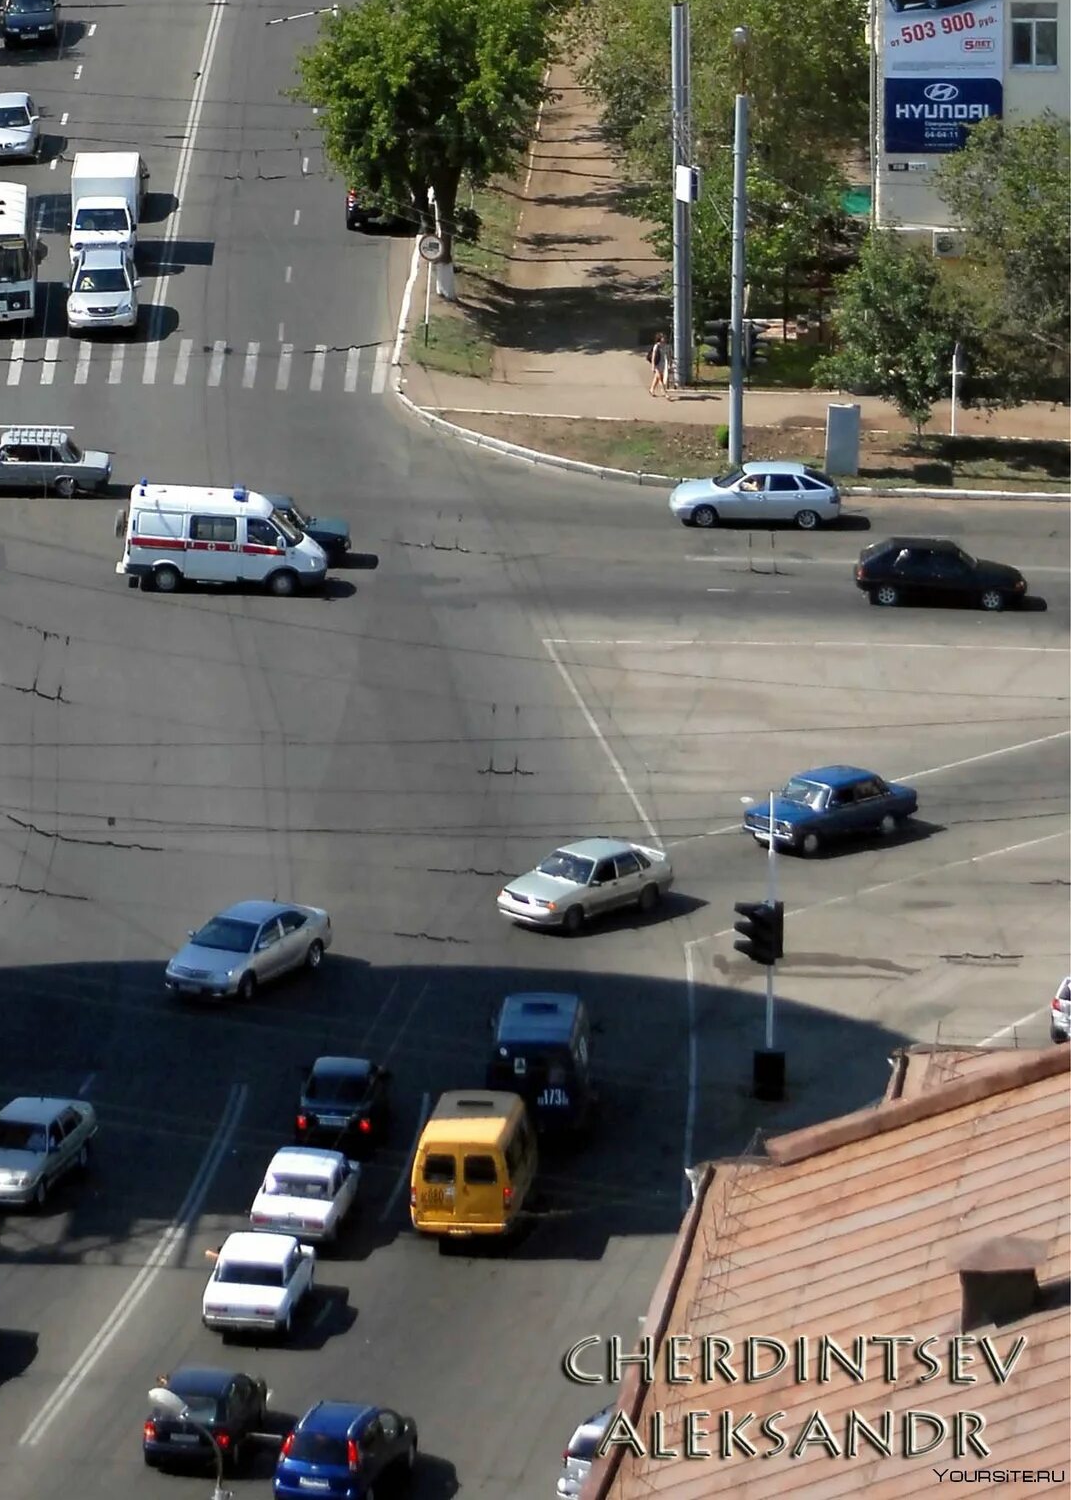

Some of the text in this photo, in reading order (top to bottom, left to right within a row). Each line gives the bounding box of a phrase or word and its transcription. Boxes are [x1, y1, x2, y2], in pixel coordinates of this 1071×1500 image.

[901, 20, 936, 44] 503
[940, 11, 976, 35] 900
[895, 103, 989, 119] HYUNDAI
